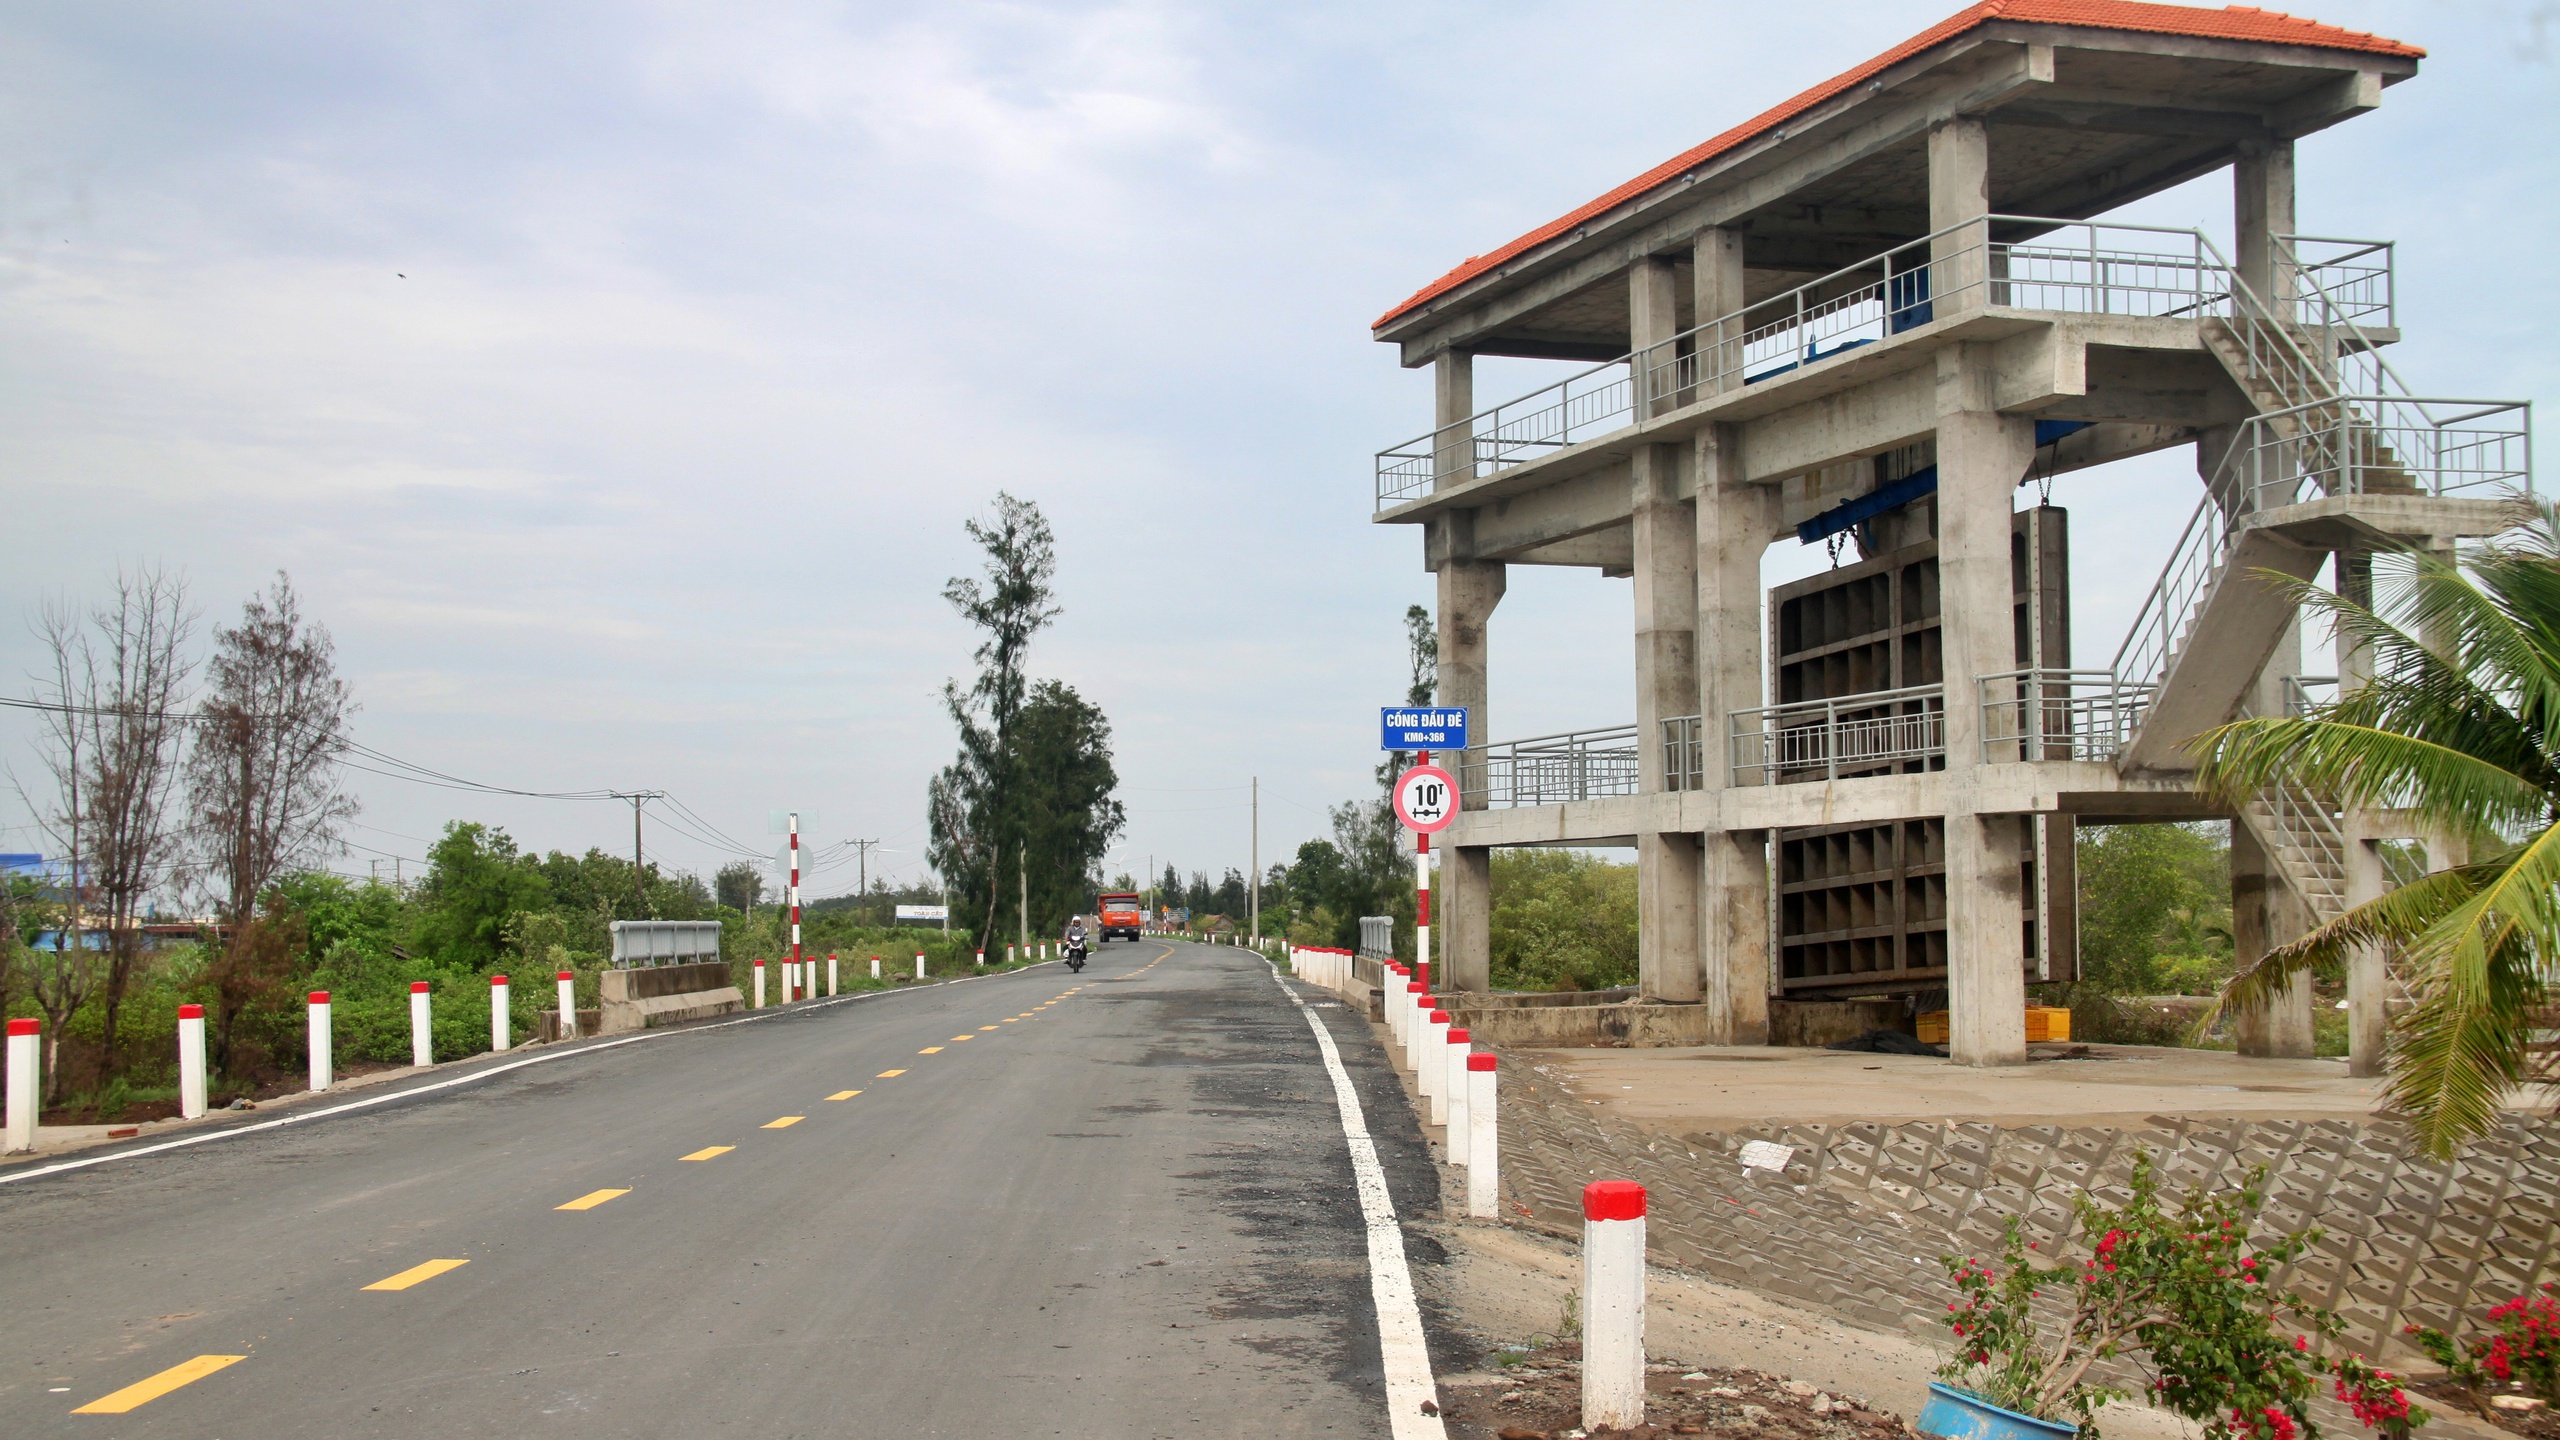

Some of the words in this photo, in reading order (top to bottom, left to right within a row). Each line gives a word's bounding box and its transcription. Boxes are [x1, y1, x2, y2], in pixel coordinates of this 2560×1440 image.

[1386, 710, 1418, 727] CỐNG
[1421, 710, 1444, 727] ĐẦU
[1447, 712, 1463, 727] ĐÊ
[1404, 732, 1445, 742] KM0+368
